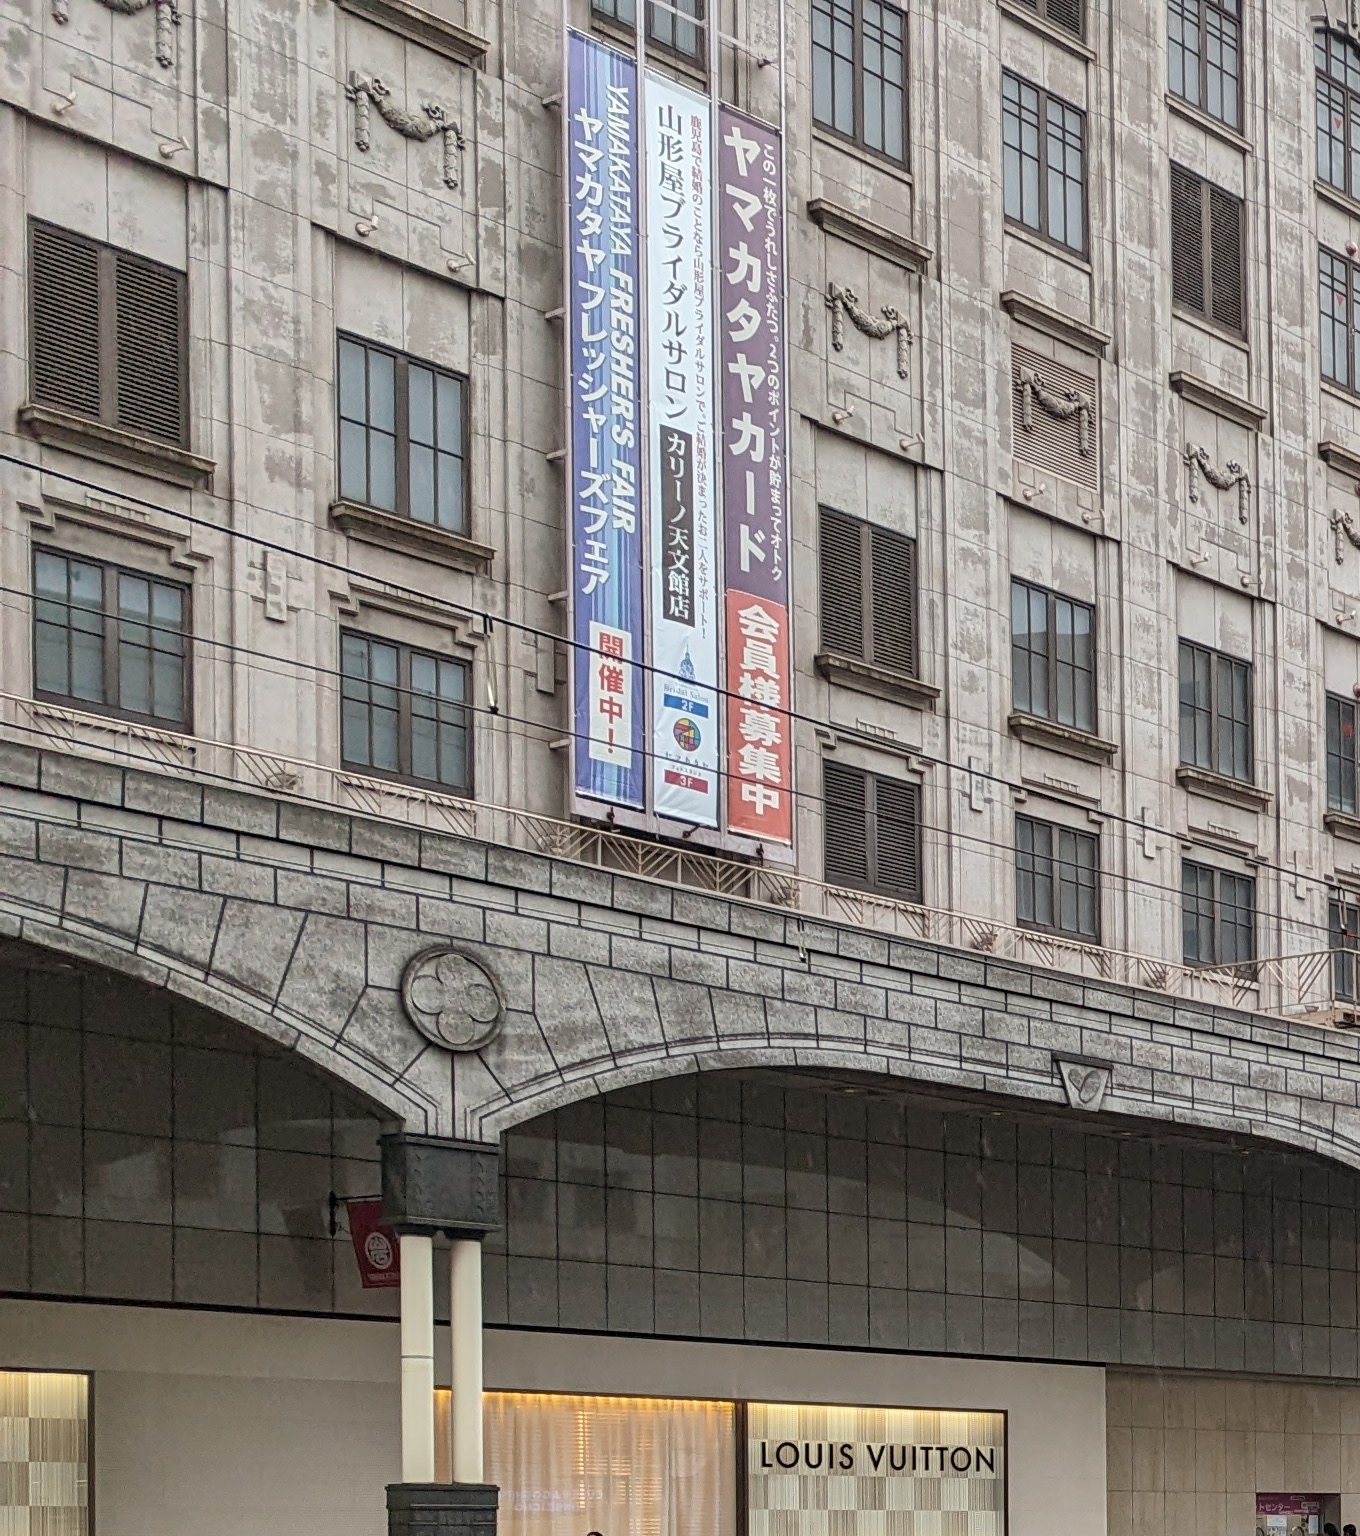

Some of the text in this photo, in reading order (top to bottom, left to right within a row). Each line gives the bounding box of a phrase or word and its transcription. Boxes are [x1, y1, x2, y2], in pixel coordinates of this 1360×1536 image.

[606, 84, 636, 535] YAMAKATAYA FRESHER'S FAIR
[658, 103, 688, 421] 山形屋ブライダルサロン
[724, 126, 767, 573] ヤマカタヤカード
[666, 431, 690, 620] カリーノ天文館店
[680, 775, 693, 788] 3F
[681, 700, 694, 712] 2F
[737, 604, 782, 818] 会員様募集中
[761, 1441, 996, 1472] LOUIS VUITTON
